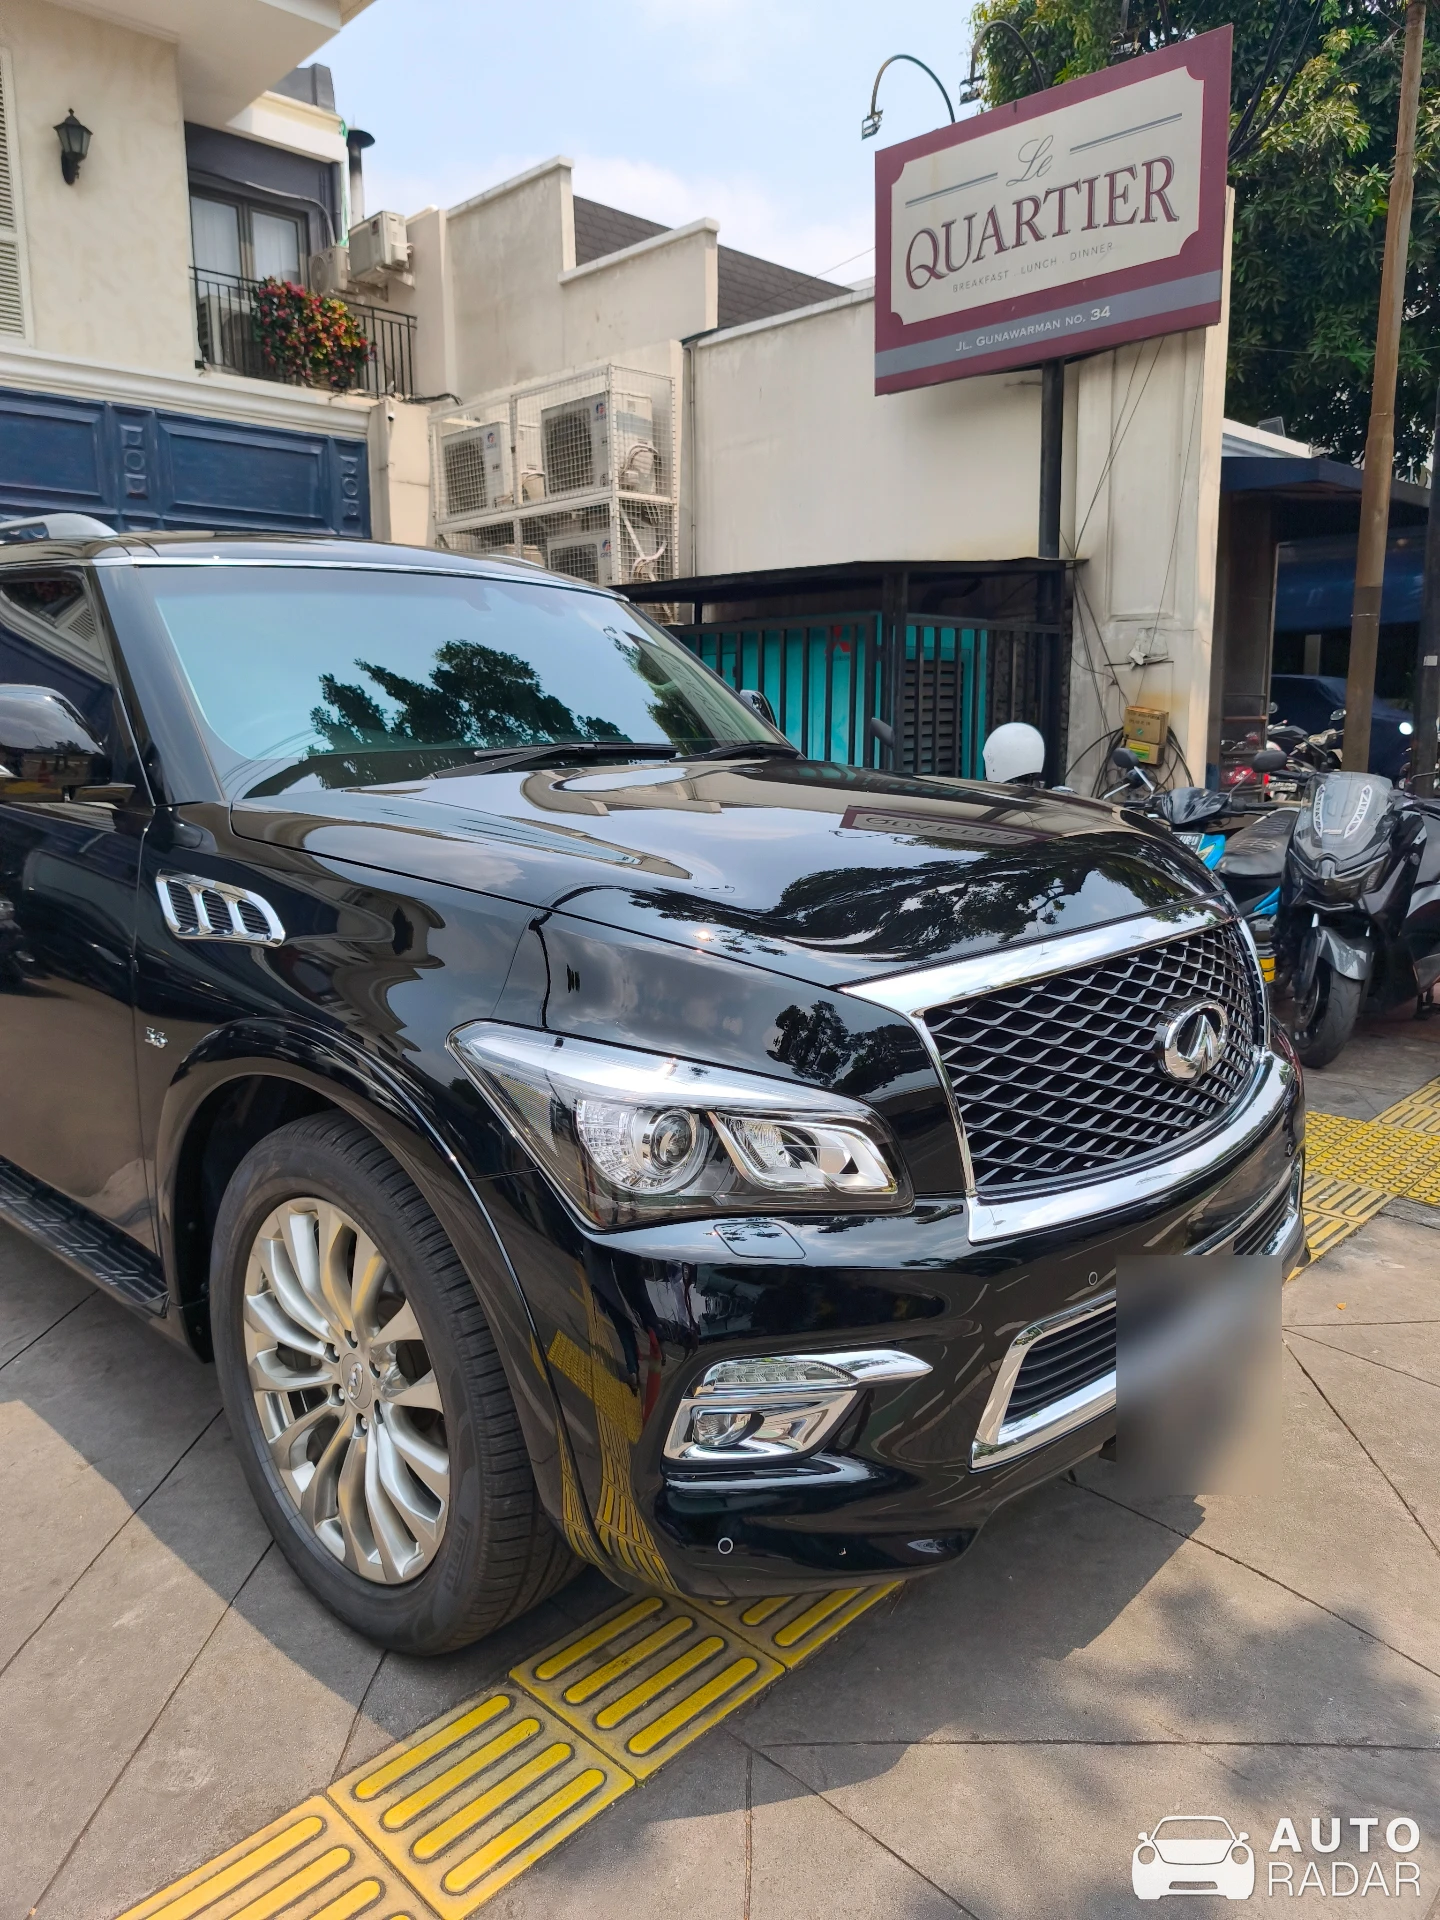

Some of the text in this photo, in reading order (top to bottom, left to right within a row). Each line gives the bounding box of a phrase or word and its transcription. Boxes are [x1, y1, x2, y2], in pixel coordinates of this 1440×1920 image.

[1005, 135, 1054, 187] Le
[905, 155, 1180, 290] QUARTIER
[952, 241, 1113, 293] BREAKFAST LUNCH DINNER
[955, 305, 1111, 352] JL. GUNAWARMAN NO. 34
